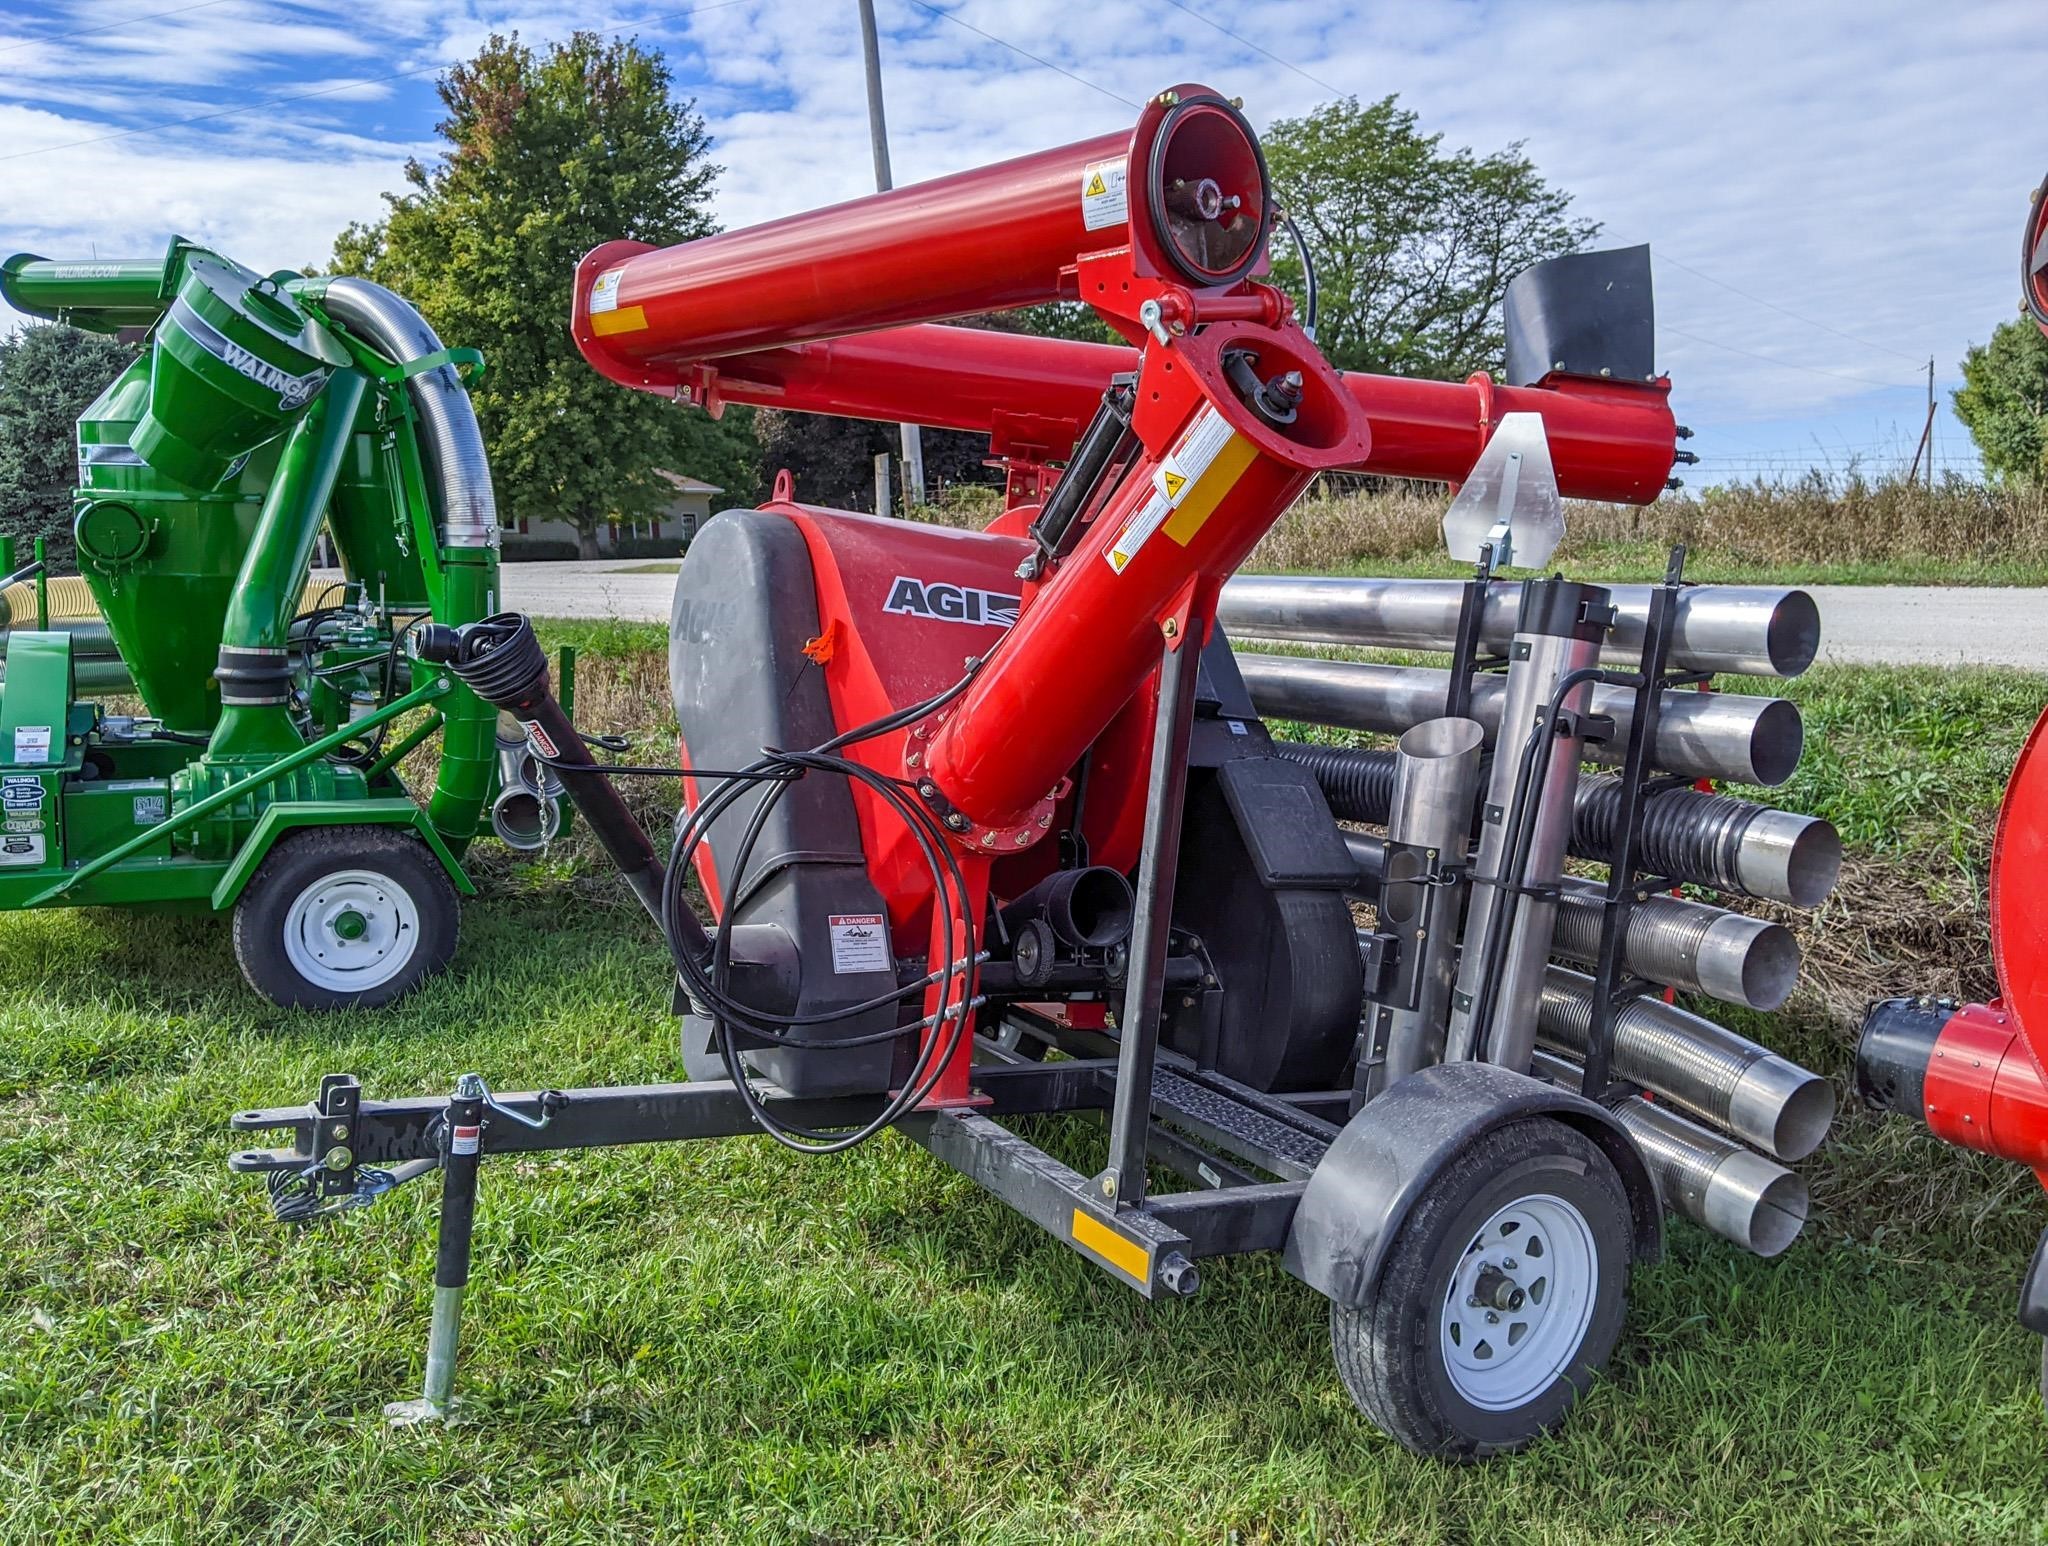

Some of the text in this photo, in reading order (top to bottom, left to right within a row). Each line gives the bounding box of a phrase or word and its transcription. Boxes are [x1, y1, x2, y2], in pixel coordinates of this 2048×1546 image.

[223, 343, 311, 401] WALINGA
[888, 579, 981, 622] AGI
[531, 730, 556, 756] DANGER
[135, 796, 165, 811] 614
[846, 917, 876, 925] DANGER
